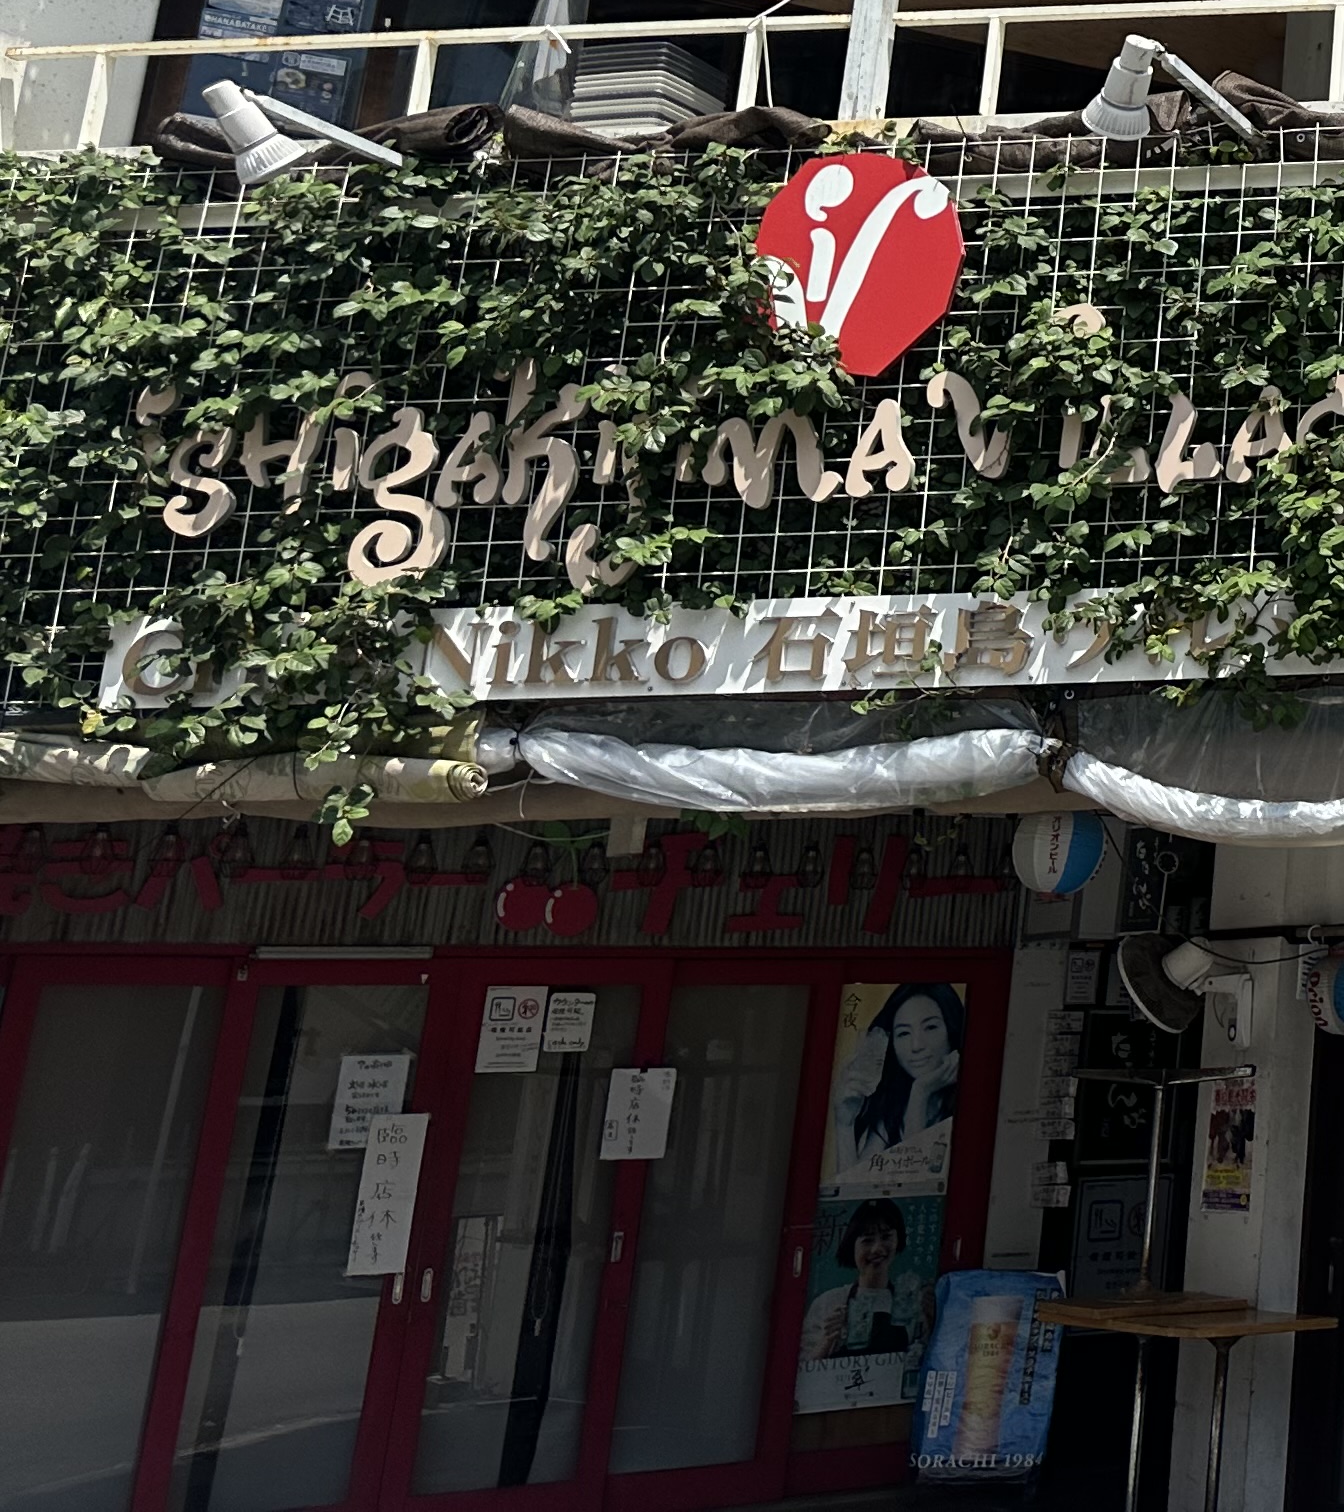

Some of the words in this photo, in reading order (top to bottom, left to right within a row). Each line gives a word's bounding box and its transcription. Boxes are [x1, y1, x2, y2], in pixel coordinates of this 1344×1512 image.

[423, 615, 711, 687] Nikko
[843, 992, 863, 1032] 今夜
[907, 1452, 998, 1470] SORACHI
[1003, 1451, 1045, 1469] 1984
